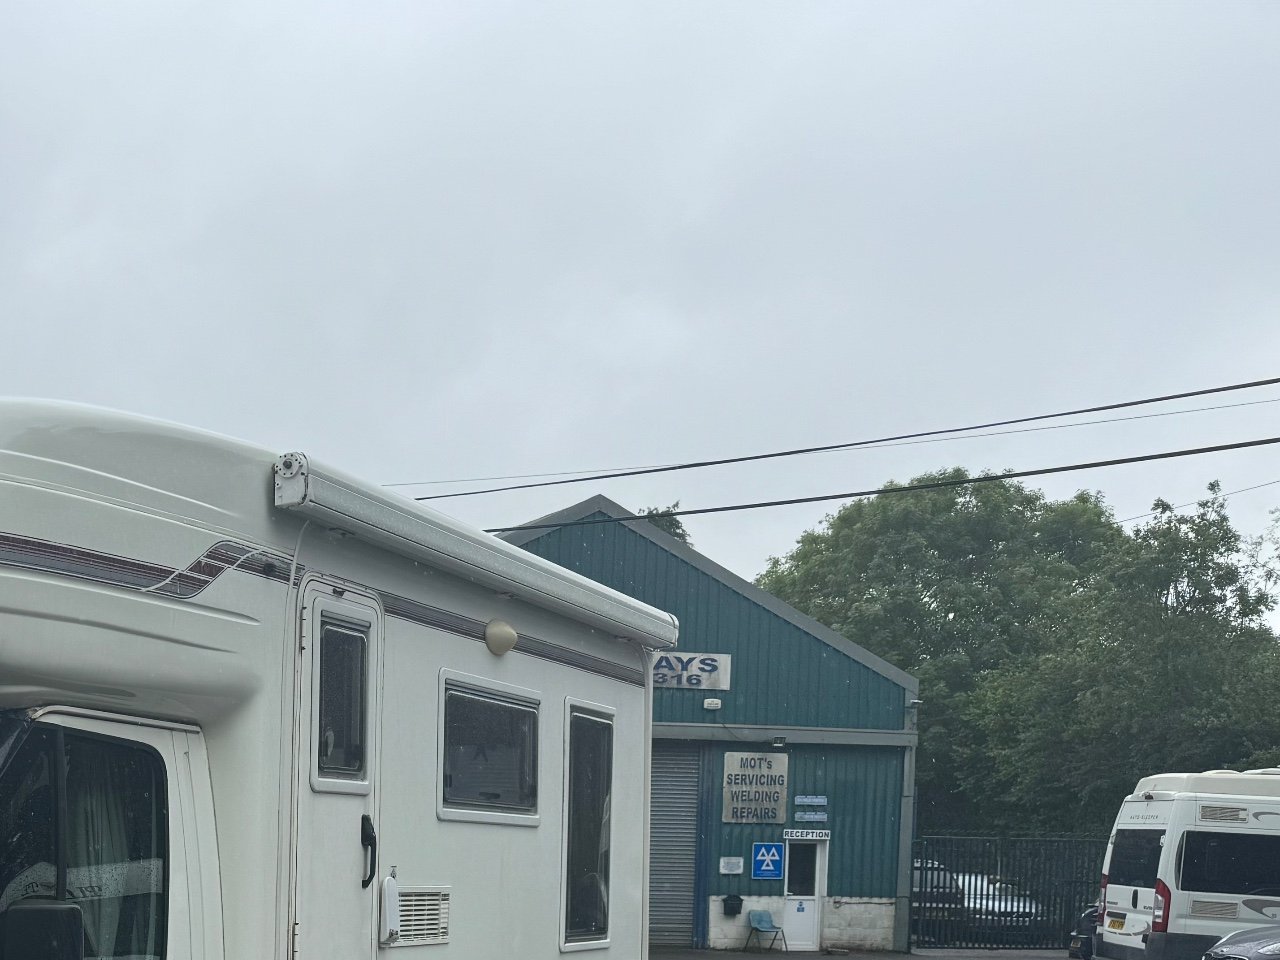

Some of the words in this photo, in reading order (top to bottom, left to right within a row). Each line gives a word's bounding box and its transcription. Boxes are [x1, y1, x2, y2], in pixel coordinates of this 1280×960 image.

[653, 655, 719, 673] AYS
[653, 672, 702, 686] 316
[740, 757, 773, 769] MOT's
[726, 773, 785, 786] SERVICING
[731, 790, 780, 803] WELDING
[732, 806, 777, 819] REPAIRS
[784, 830, 830, 839] RECEPTION
